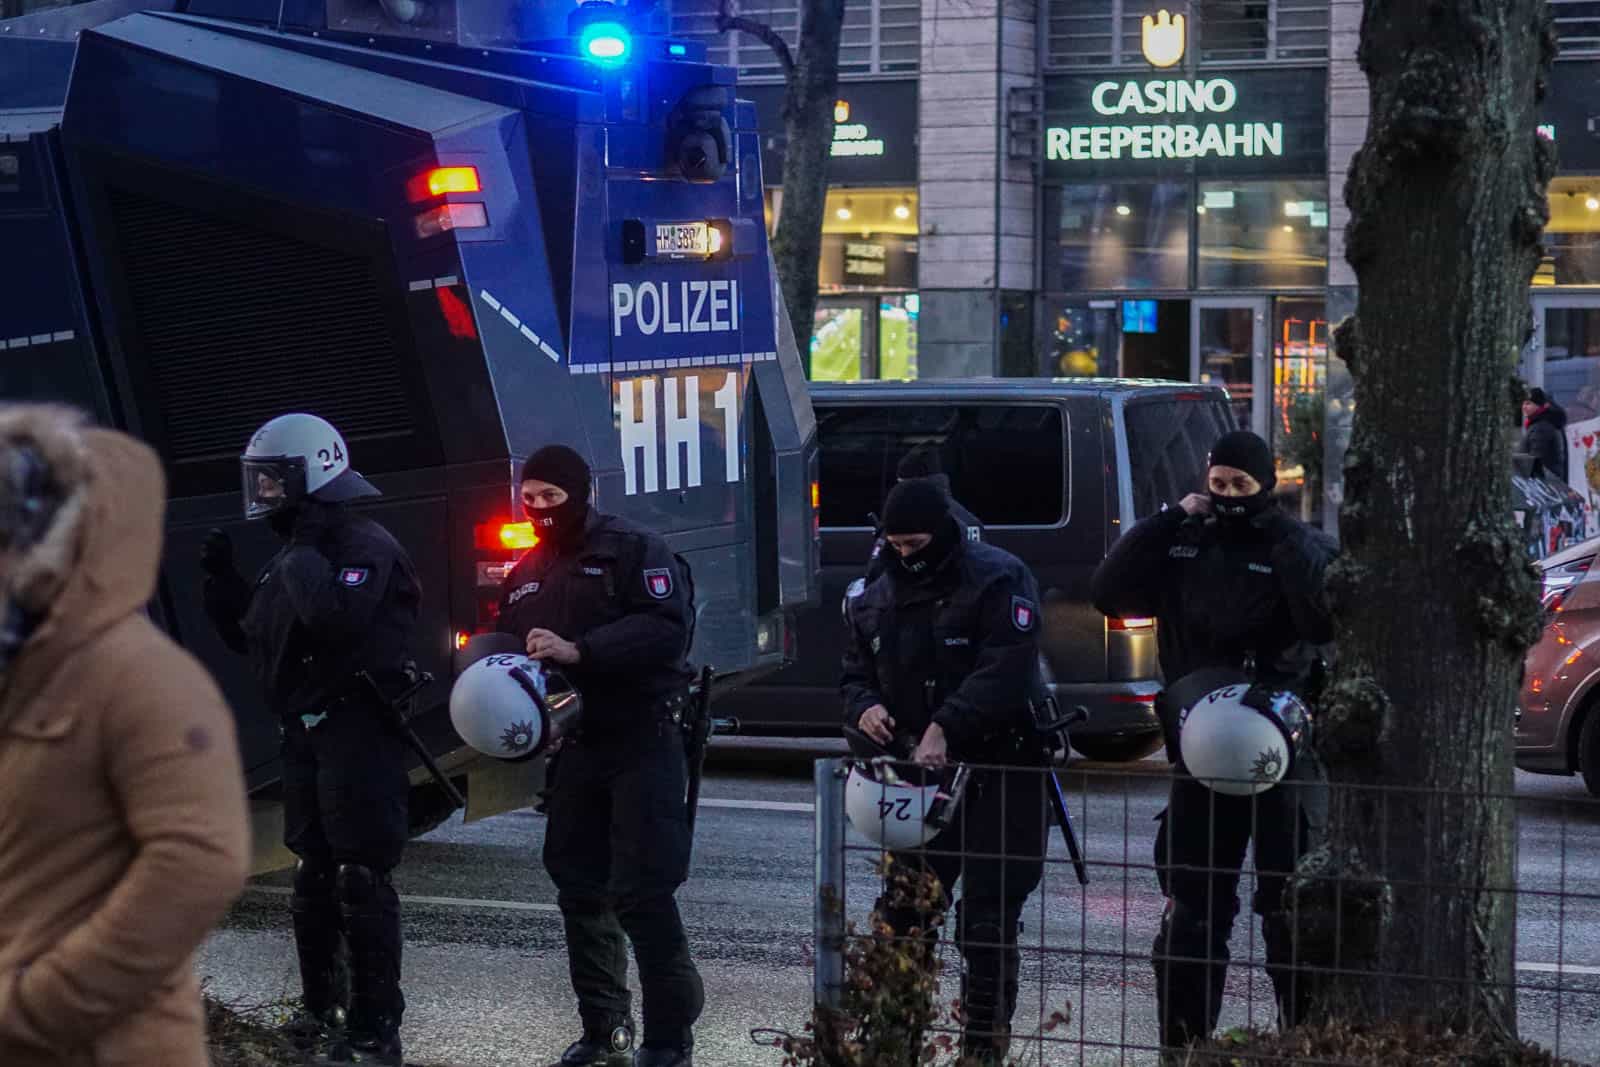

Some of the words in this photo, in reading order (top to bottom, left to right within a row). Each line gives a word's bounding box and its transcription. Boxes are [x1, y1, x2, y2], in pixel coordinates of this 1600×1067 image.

[1091, 79, 1237, 115] CASINO
[1047, 122, 1283, 160] REEPERBAHN
[612, 280, 738, 336] POLIZEI
[617, 374, 701, 495] HH
[714, 372, 739, 483] 1
[317, 441, 344, 472] 24
[485, 655, 515, 667] 24
[877, 798, 912, 821] 24
